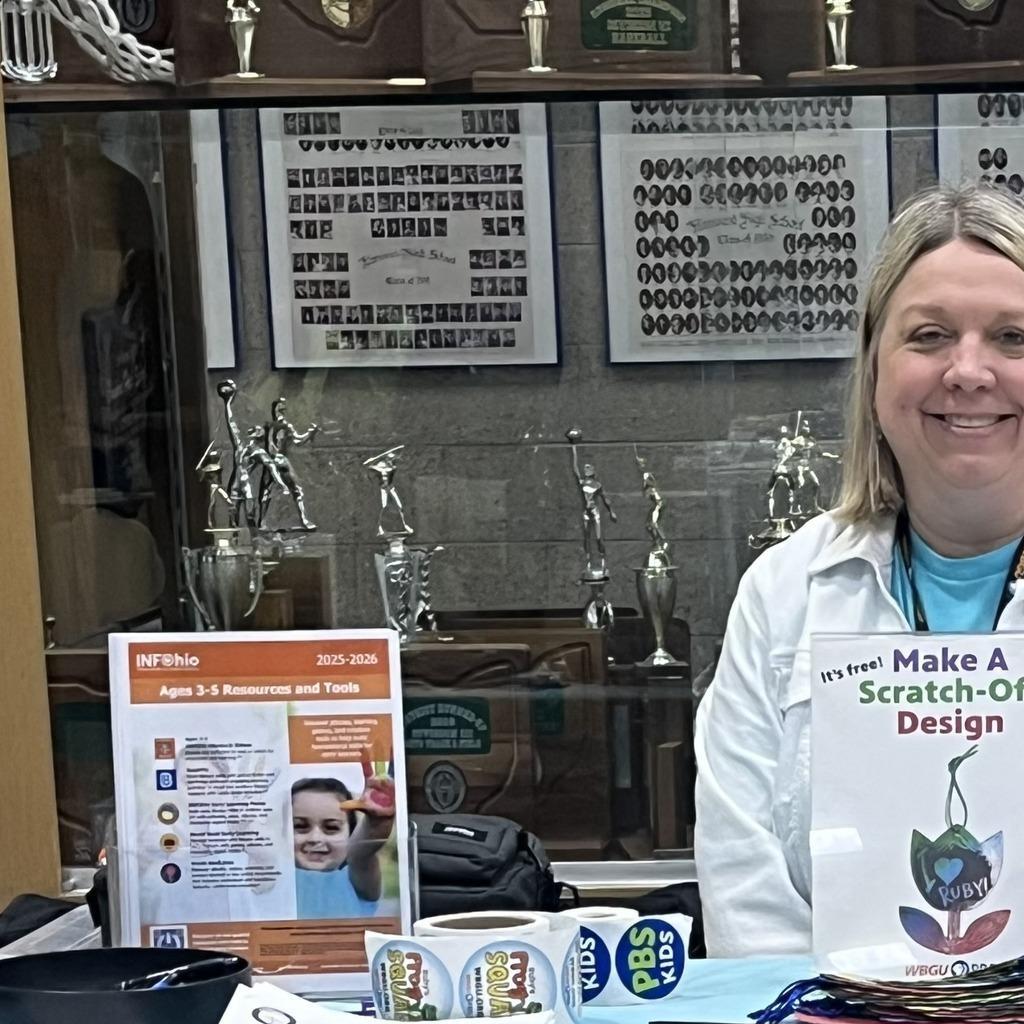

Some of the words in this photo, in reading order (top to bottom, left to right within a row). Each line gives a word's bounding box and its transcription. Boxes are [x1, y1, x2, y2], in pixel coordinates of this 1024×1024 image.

[316, 653, 378, 666] 2025-2026
[820, 669, 844, 685] It's
[847, 656, 883, 677] free!
[893, 647, 978, 673] Make
[987, 647, 1009, 672] A
[160, 685, 193, 699] Ages
[196, 684, 219, 697] 3-5
[222, 684, 291, 696] Resources
[295, 682, 320, 694] and
[324, 682, 360, 694] Tools
[897, 709, 1004, 740] Design
[580, 937, 599, 990] KIDS
[628, 926, 660, 993] PBS
[659, 930, 677, 985] KIDS
[905, 965, 949, 976] WBGU
[485, 951, 512, 1018] SQUA
